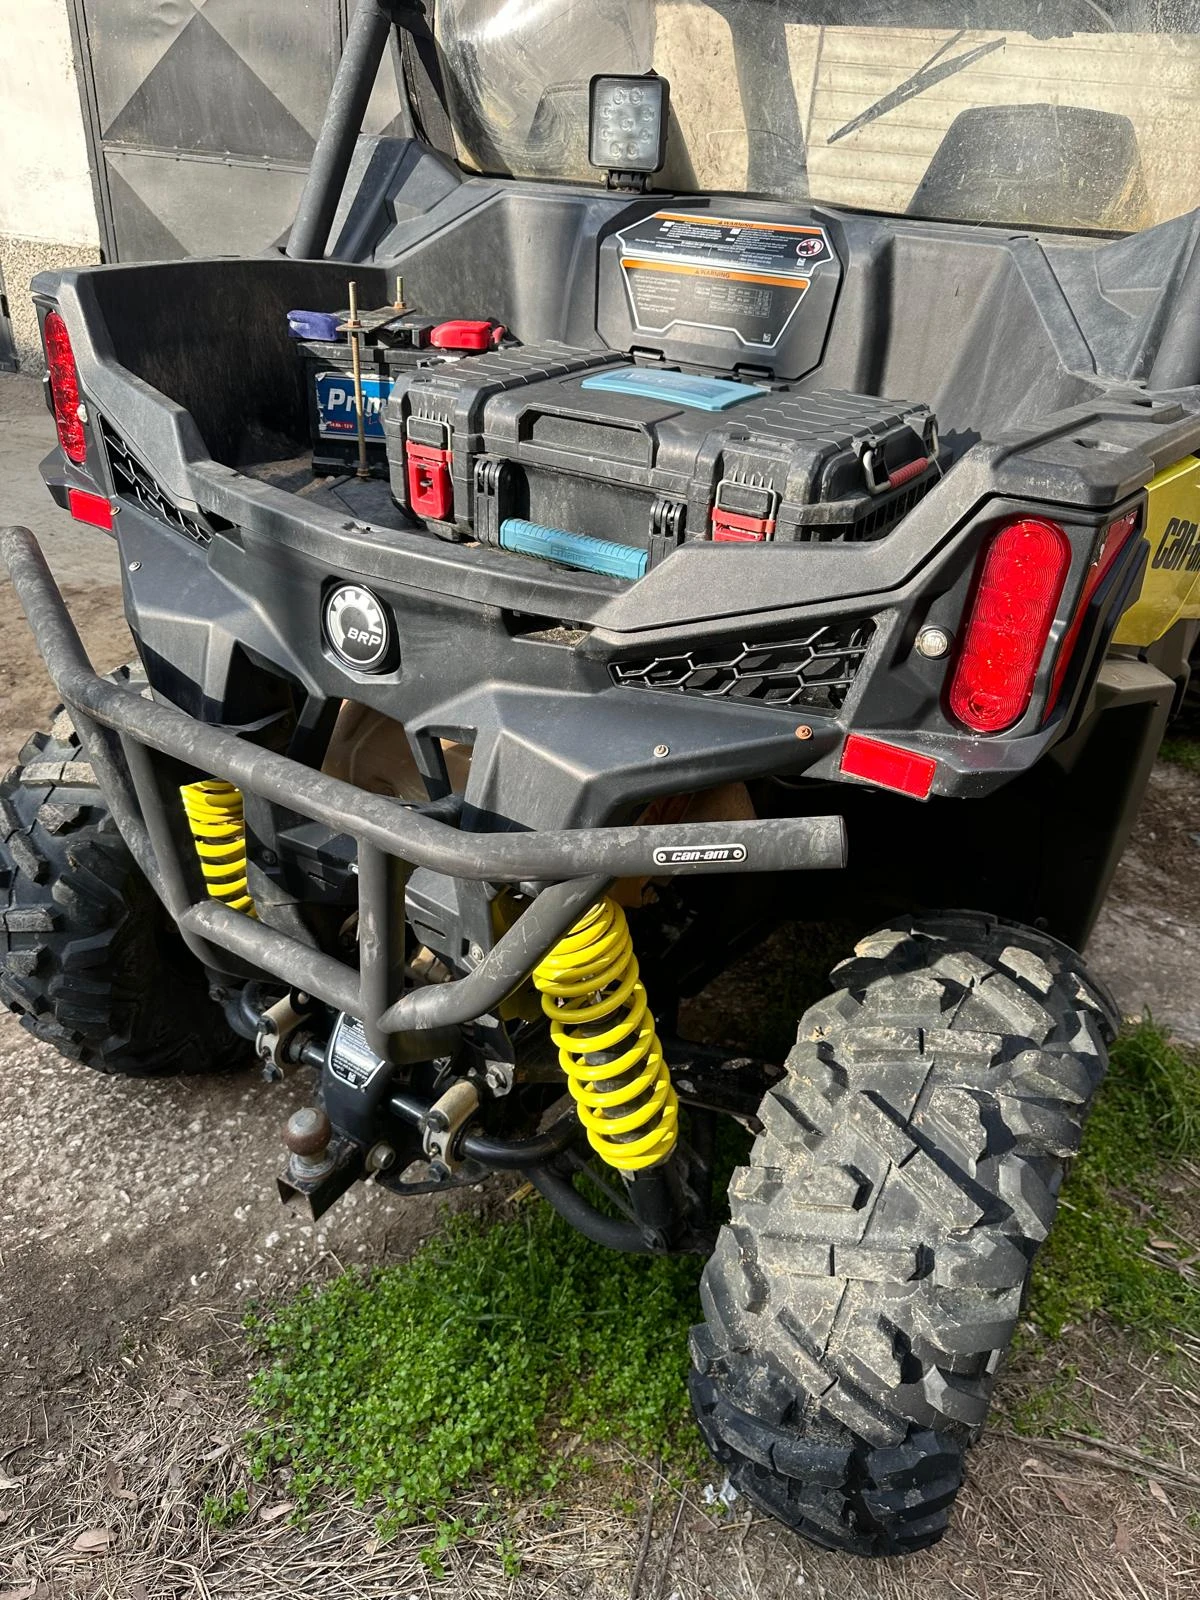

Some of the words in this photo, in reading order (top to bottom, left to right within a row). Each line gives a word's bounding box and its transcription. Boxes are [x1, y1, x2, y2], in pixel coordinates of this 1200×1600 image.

[724, 220, 754, 228] WARNING
[700, 269, 730, 278] WARNING
[347, 626, 381, 647] BRP
[671, 849, 730, 861] can-am
